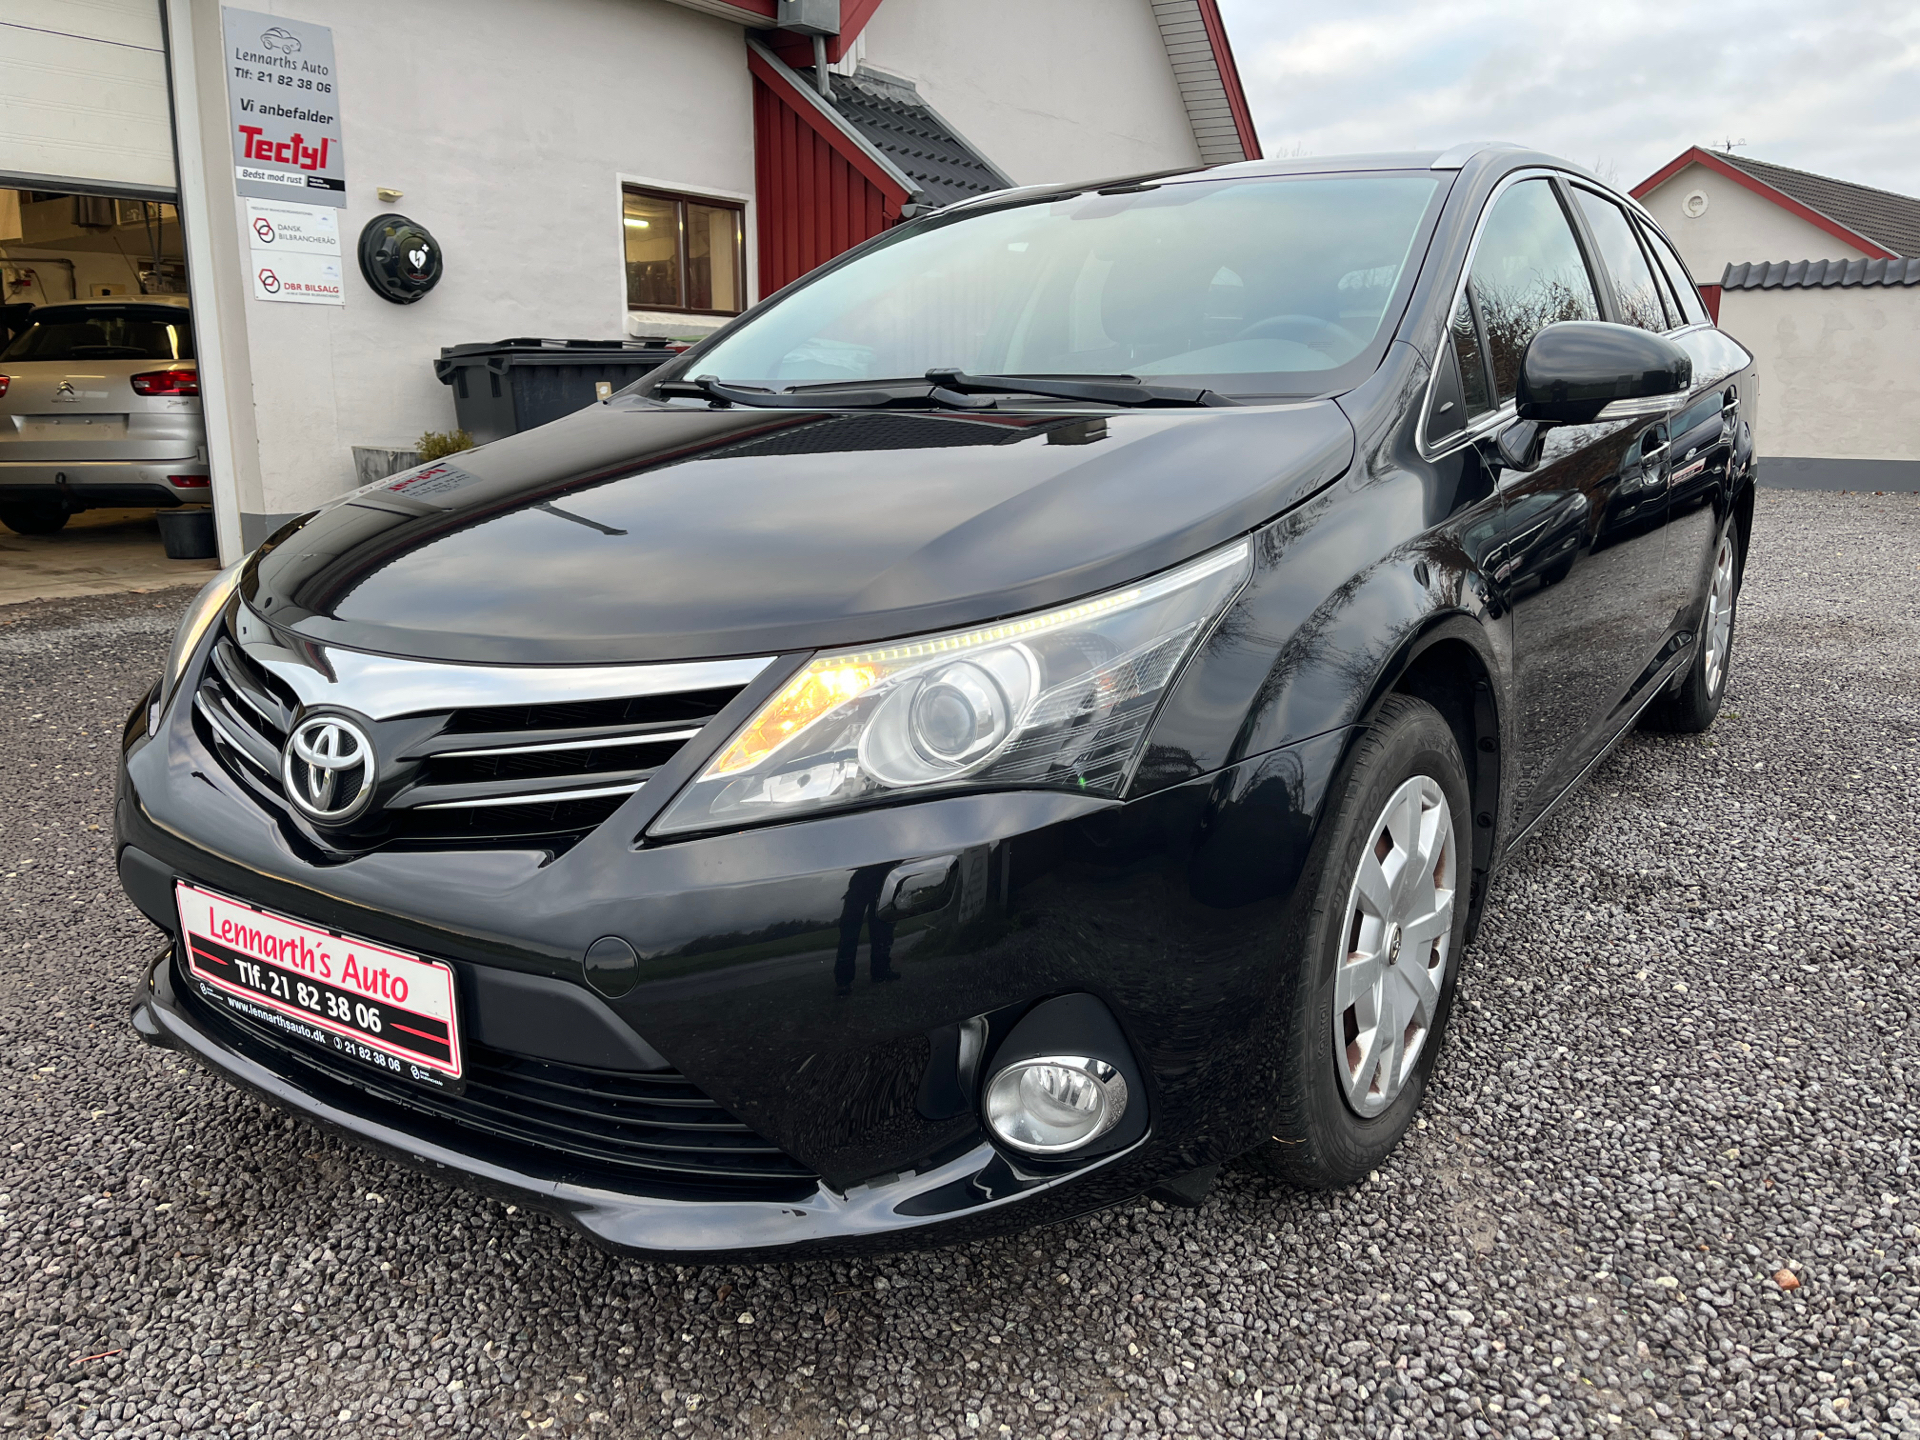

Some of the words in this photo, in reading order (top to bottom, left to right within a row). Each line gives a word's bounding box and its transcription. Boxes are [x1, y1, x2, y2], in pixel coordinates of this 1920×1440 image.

[235, 47, 297, 72] Lennarths
[301, 60, 329, 76] Auto
[234, 67, 253, 80] Tlf:
[257, 71, 273, 84] 21
[277, 75, 294, 88] 82
[297, 78, 313, 91] 38
[316, 82, 332, 94] 06
[240, 98, 254, 112] Vi
[259, 101, 334, 125] anbefalder
[238, 124, 329, 171] Tectyl
[242, 169, 266, 181] Bedst
[267, 173, 285, 183] mod
[286, 174, 303, 185] rust
[277, 223, 303, 234] DANSK
[278, 232, 336, 245] BILBRANCHERÅD
[284, 282, 303, 292] DBR
[305, 283, 340, 294] BILSALG
[341, 953, 409, 1003] Auto
[234, 959, 267, 992] Tlf.
[270, 972, 290, 1000] 21
[297, 982, 321, 1012] 82
[326, 992, 351, 1022] 38
[355, 1003, 382, 1033] 06
[227, 996, 326, 1045] www.lennarthsauto.dk
[344, 1041, 356, 1055] 21
[359, 1046, 371, 1061] 82
[373, 1051, 386, 1067] 38
[388, 1058, 401, 1073] 06
